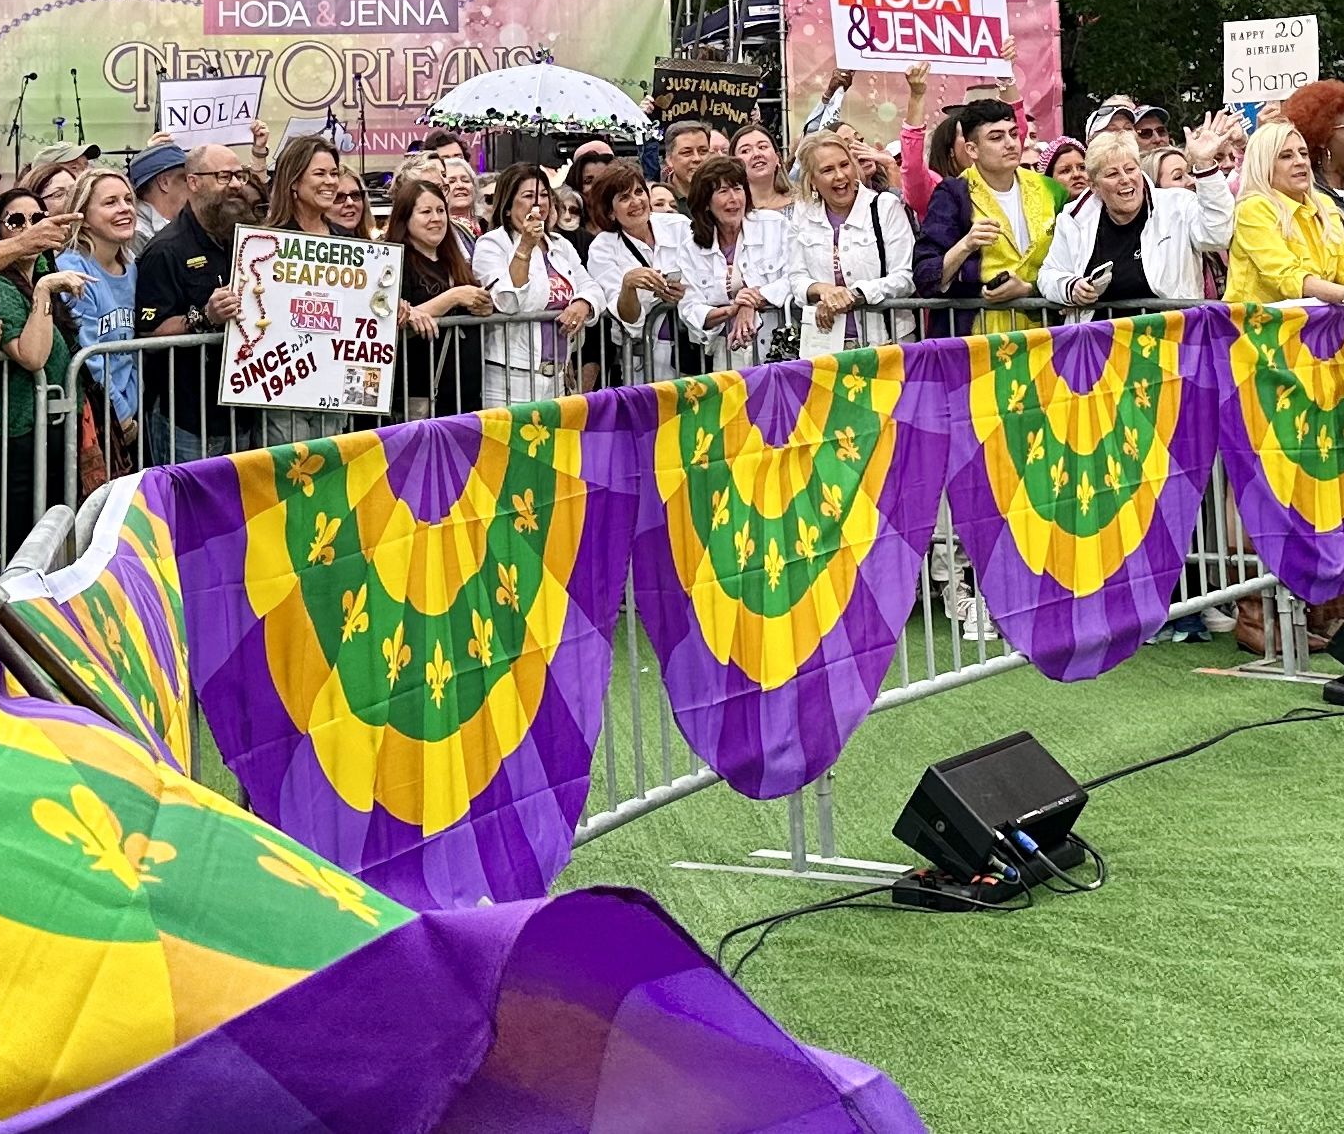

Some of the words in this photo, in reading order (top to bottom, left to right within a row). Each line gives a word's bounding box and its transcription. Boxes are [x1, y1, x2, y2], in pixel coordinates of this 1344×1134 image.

[218, 0, 312, 28] HODA
[316, 0, 337, 28] &
[341, 0, 449, 27] JENNA
[1230, 30, 1265, 42] HAPPY
[1246, 43, 1296, 56] BIRTHDAY
[666, 77, 698, 93] JUST
[1231, 67, 1308, 94] Shane
[167, 100, 252, 127] NOLA
[661, 98, 698, 122] HODA
[277, 237, 365, 267] JAEGERS
[272, 260, 368, 290] SEAFOOD
[296, 299, 331, 315] HODA
[355, 318, 378, 340] 76
[331, 339, 394, 365] YEARS
[230, 341, 292, 395] SINCE
[261, 351, 318, 402] 1948!
